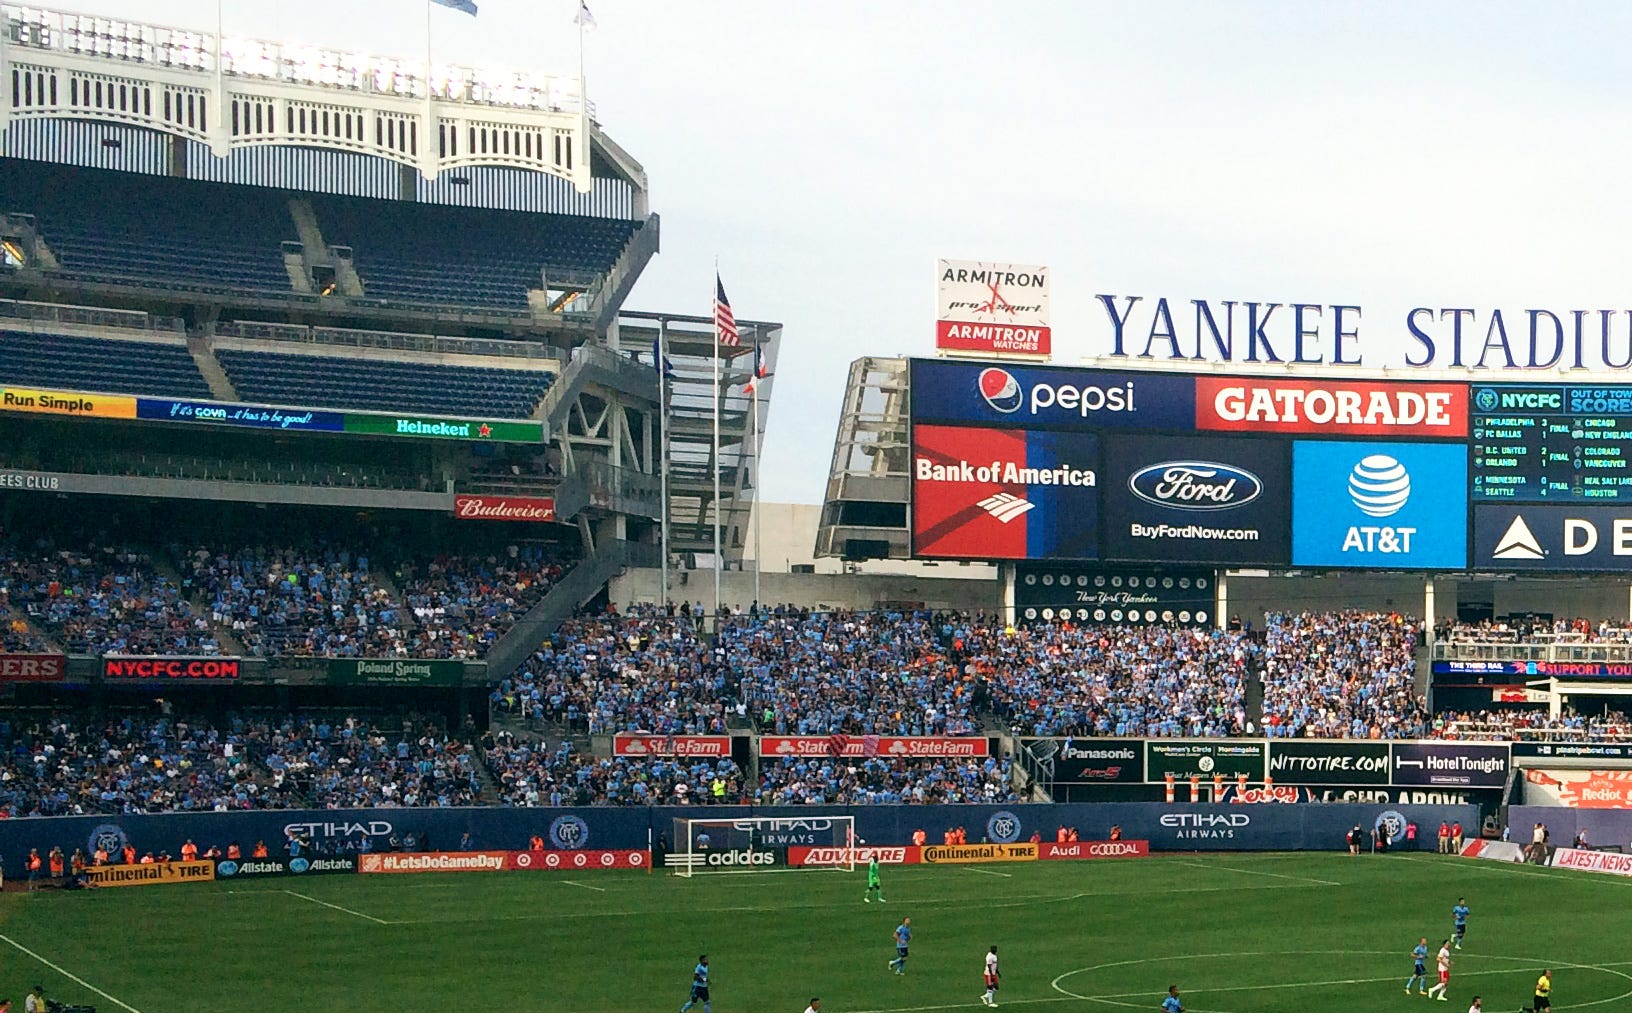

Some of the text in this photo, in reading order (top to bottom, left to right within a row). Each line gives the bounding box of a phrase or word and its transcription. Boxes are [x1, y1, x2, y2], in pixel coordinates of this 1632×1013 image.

[943, 268, 1044, 288] ARMITRON
[947, 325, 1040, 342] ARMITRON
[1095, 294, 1363, 366] YANKEE
[993, 340, 1038, 351] WATCHES
[4, 392, 94, 412] Run Simple
[1031, 382, 1134, 416] pepsi
[1502, 393, 1561, 408] NYCFC
[1571, 390, 1593, 399] OUT
[1596, 390, 1607, 399] OF
[195, 408, 226, 418] GOYA
[1214, 386, 1451, 427] GATORADE
[397, 419, 469, 437] Heineken
[916, 458, 1096, 487] Bank of America
[26, 477, 59, 490] CLUB
[1156, 468, 1236, 503] Ford
[456, 499, 553, 519] Budweiser
[1131, 524, 1259, 541] BuyFordNow.com
[1342, 526, 1416, 554] AT&T
[1, 658, 58, 677] ERS
[106, 660, 239, 679] NYCFC.COM
[357, 661, 431, 677] Poland Spring
[1547, 664, 1600, 675] SUPPORT
[1067, 748, 1136, 760] Panasonic
[1270, 753, 1389, 772] NITTOTIRE.COM
[1427, 755, 1504, 773] HotelTonight
[1582, 788, 1622, 801] RedHot
[1159, 813, 1250, 827] ETIHAD
[284, 822, 392, 837] ETIHAD
[1176, 830, 1234, 838] AIRWAYS
[708, 849, 774, 866] adidas
[804, 848, 906, 864] ADVOCARE
[924, 846, 1035, 862] Continental TIRE
[1050, 845, 1080, 856] Audi
[239, 861, 283, 874] Allstate
[309, 858, 352, 871] Allstate
[384, 854, 503, 870] #LetsDoGameDay
[1559, 851, 1600, 871] LATEST
[1600, 855, 1632, 873] NEWS
[178, 865, 211, 878] TIRE
